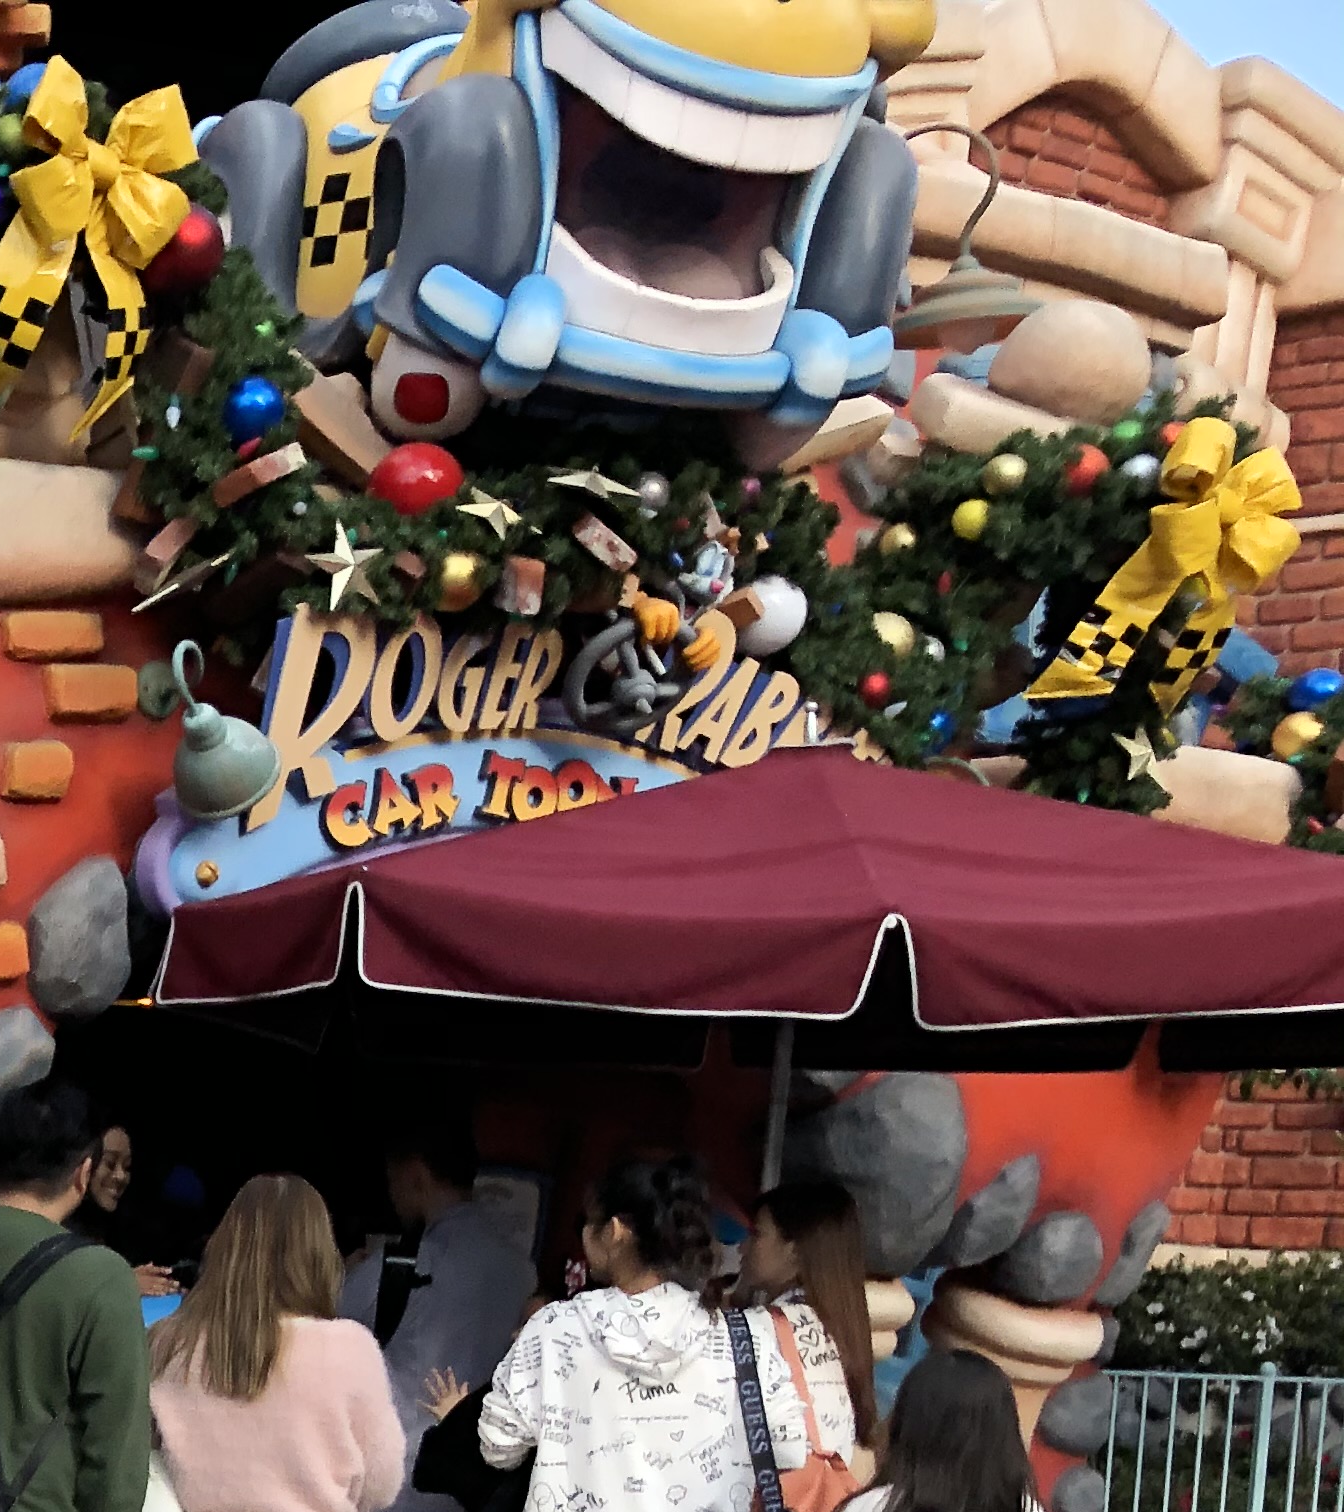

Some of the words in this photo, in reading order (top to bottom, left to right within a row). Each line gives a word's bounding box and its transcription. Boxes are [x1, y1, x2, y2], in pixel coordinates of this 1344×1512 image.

[246, 602, 563, 832] ROGER
[321, 764, 461, 850] CAR
[618, 1377, 680, 1403] Puma
[740, 1380, 770, 1454] GUESS
